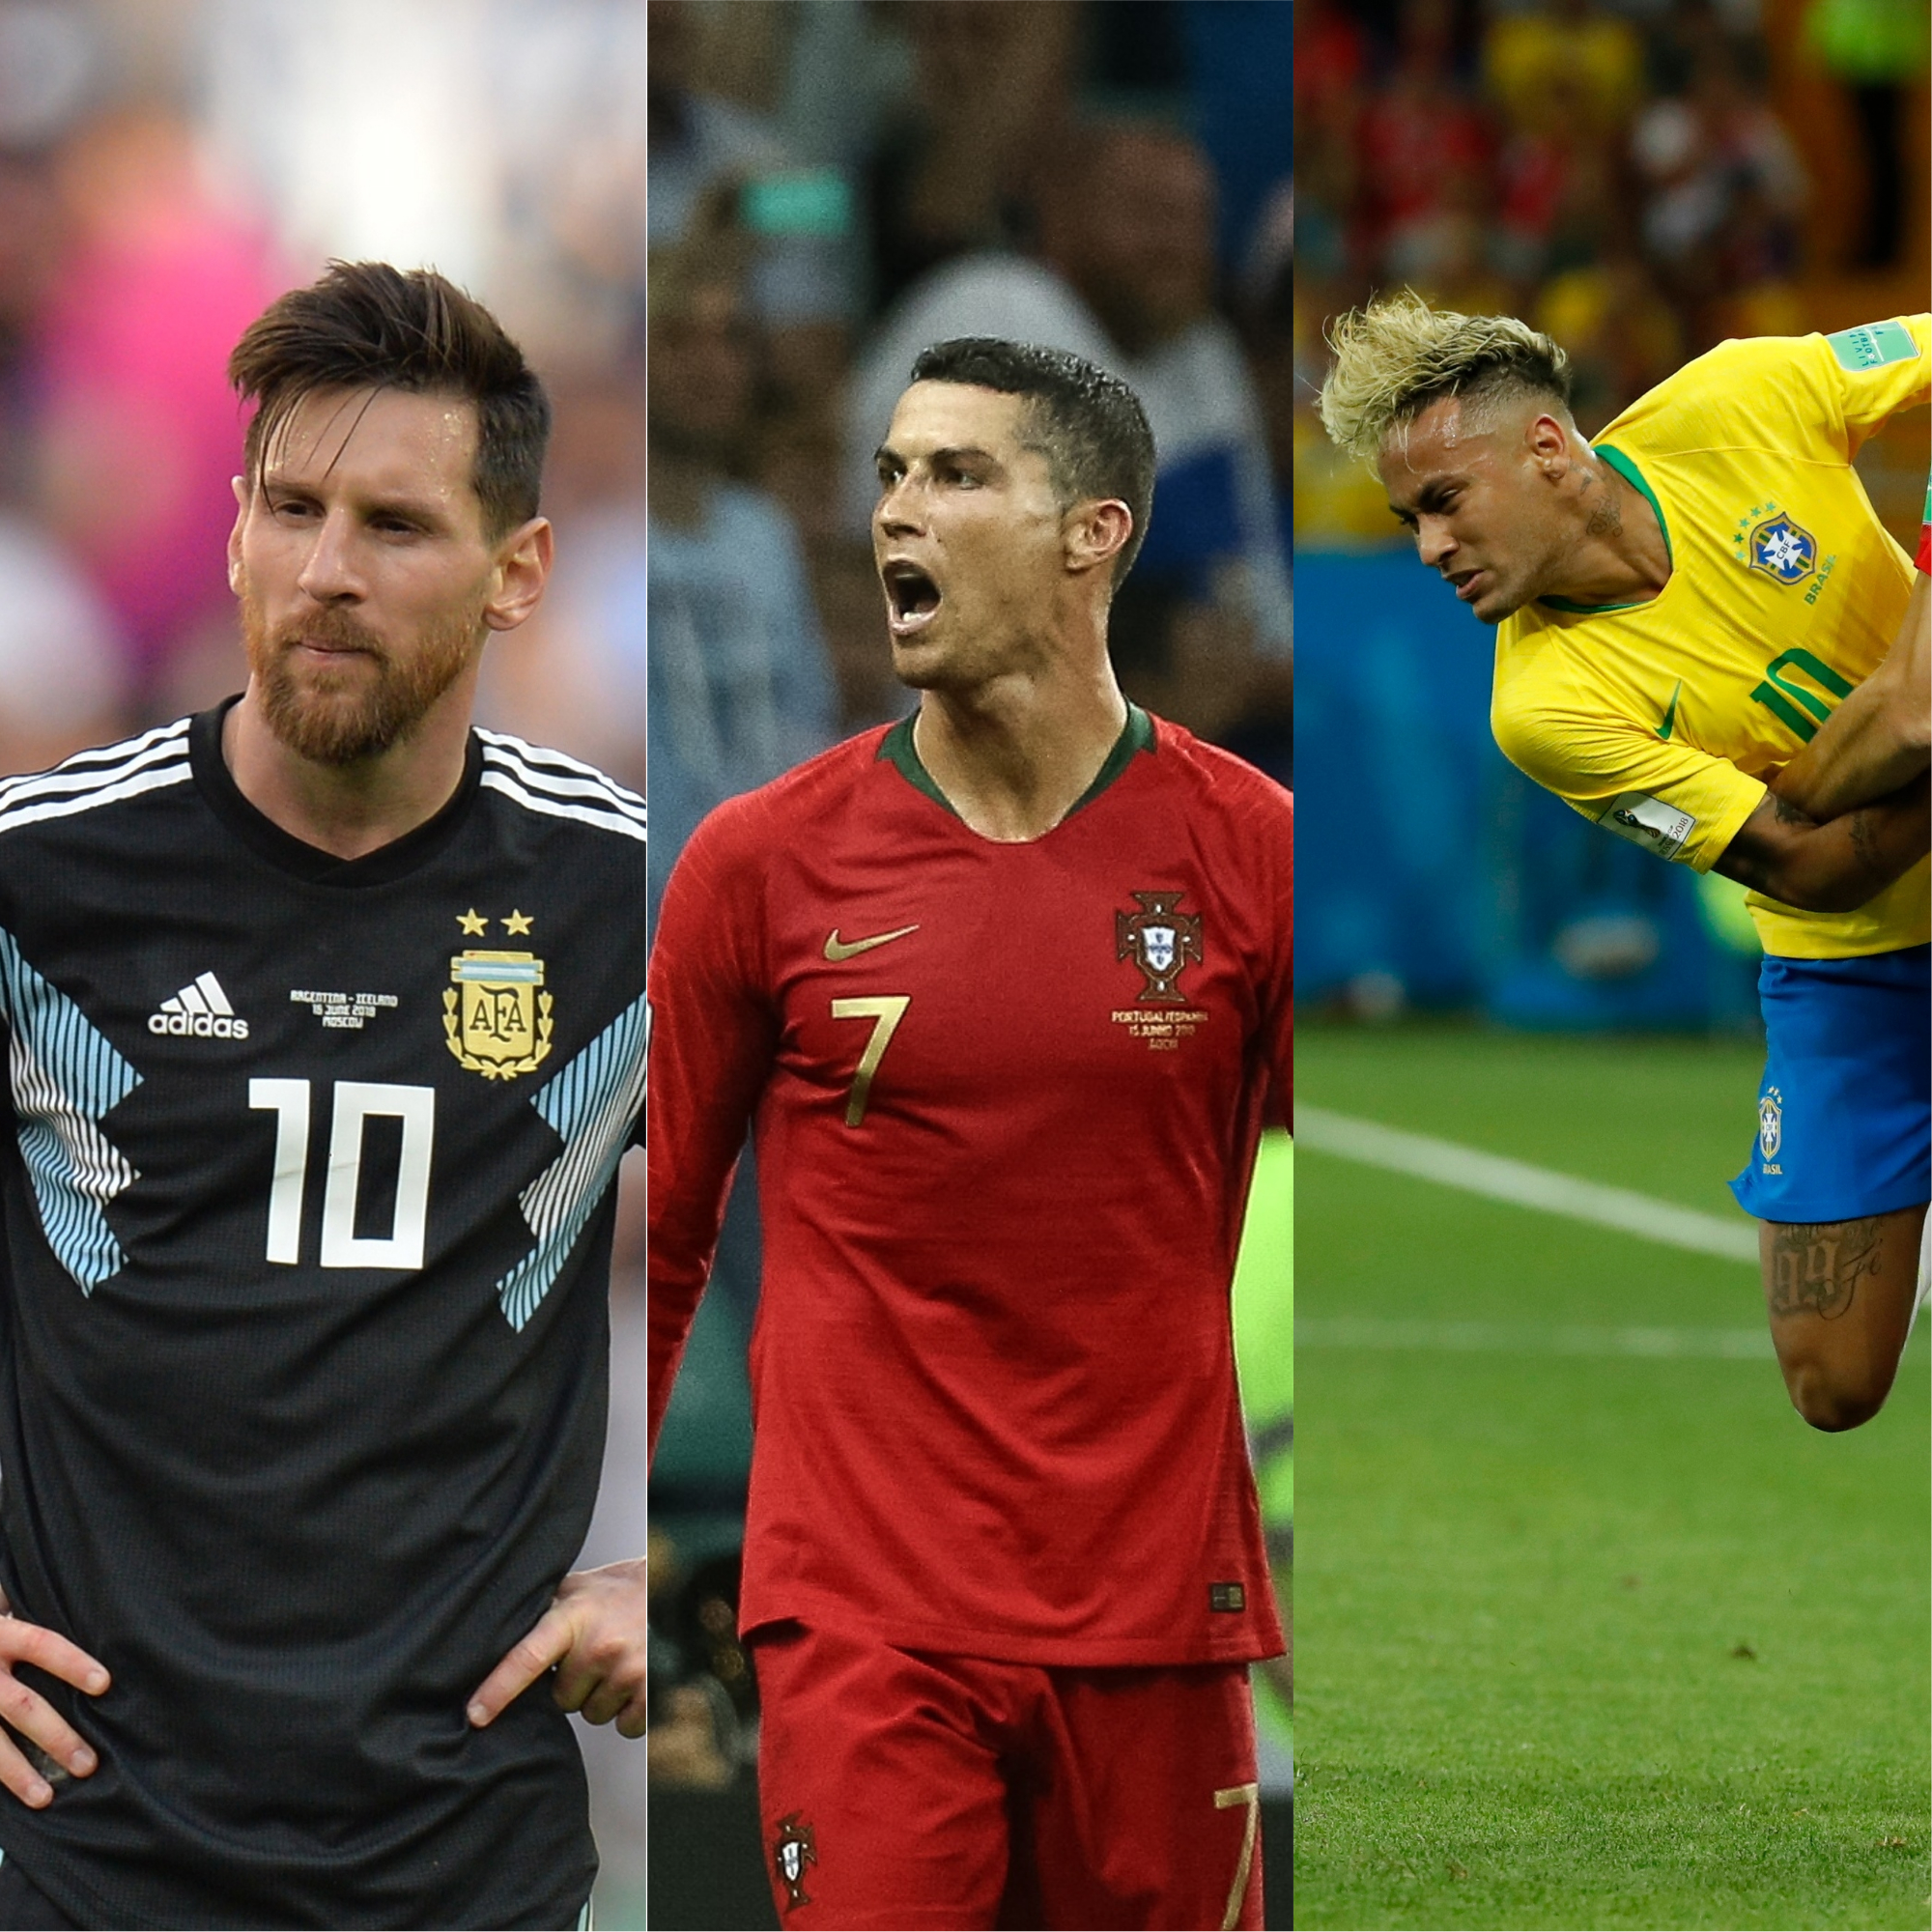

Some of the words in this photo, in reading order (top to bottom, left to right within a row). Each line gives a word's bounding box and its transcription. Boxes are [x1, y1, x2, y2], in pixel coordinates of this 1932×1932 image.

[1776, 539, 1791, 559] CBF
[1804, 554, 1837, 606] BRASIL
[1672, 817, 1689, 838] 2018
[355, 993, 399, 1008] ICELAND
[469, 983, 527, 1043] AFA
[148, 1010, 249, 1039] adidas
[322, 1015, 364, 1029] MOSCOW
[832, 996, 912, 1127] 7
[248, 1077, 436, 1270] 10
[1213, 1781, 1259, 1931] 7
